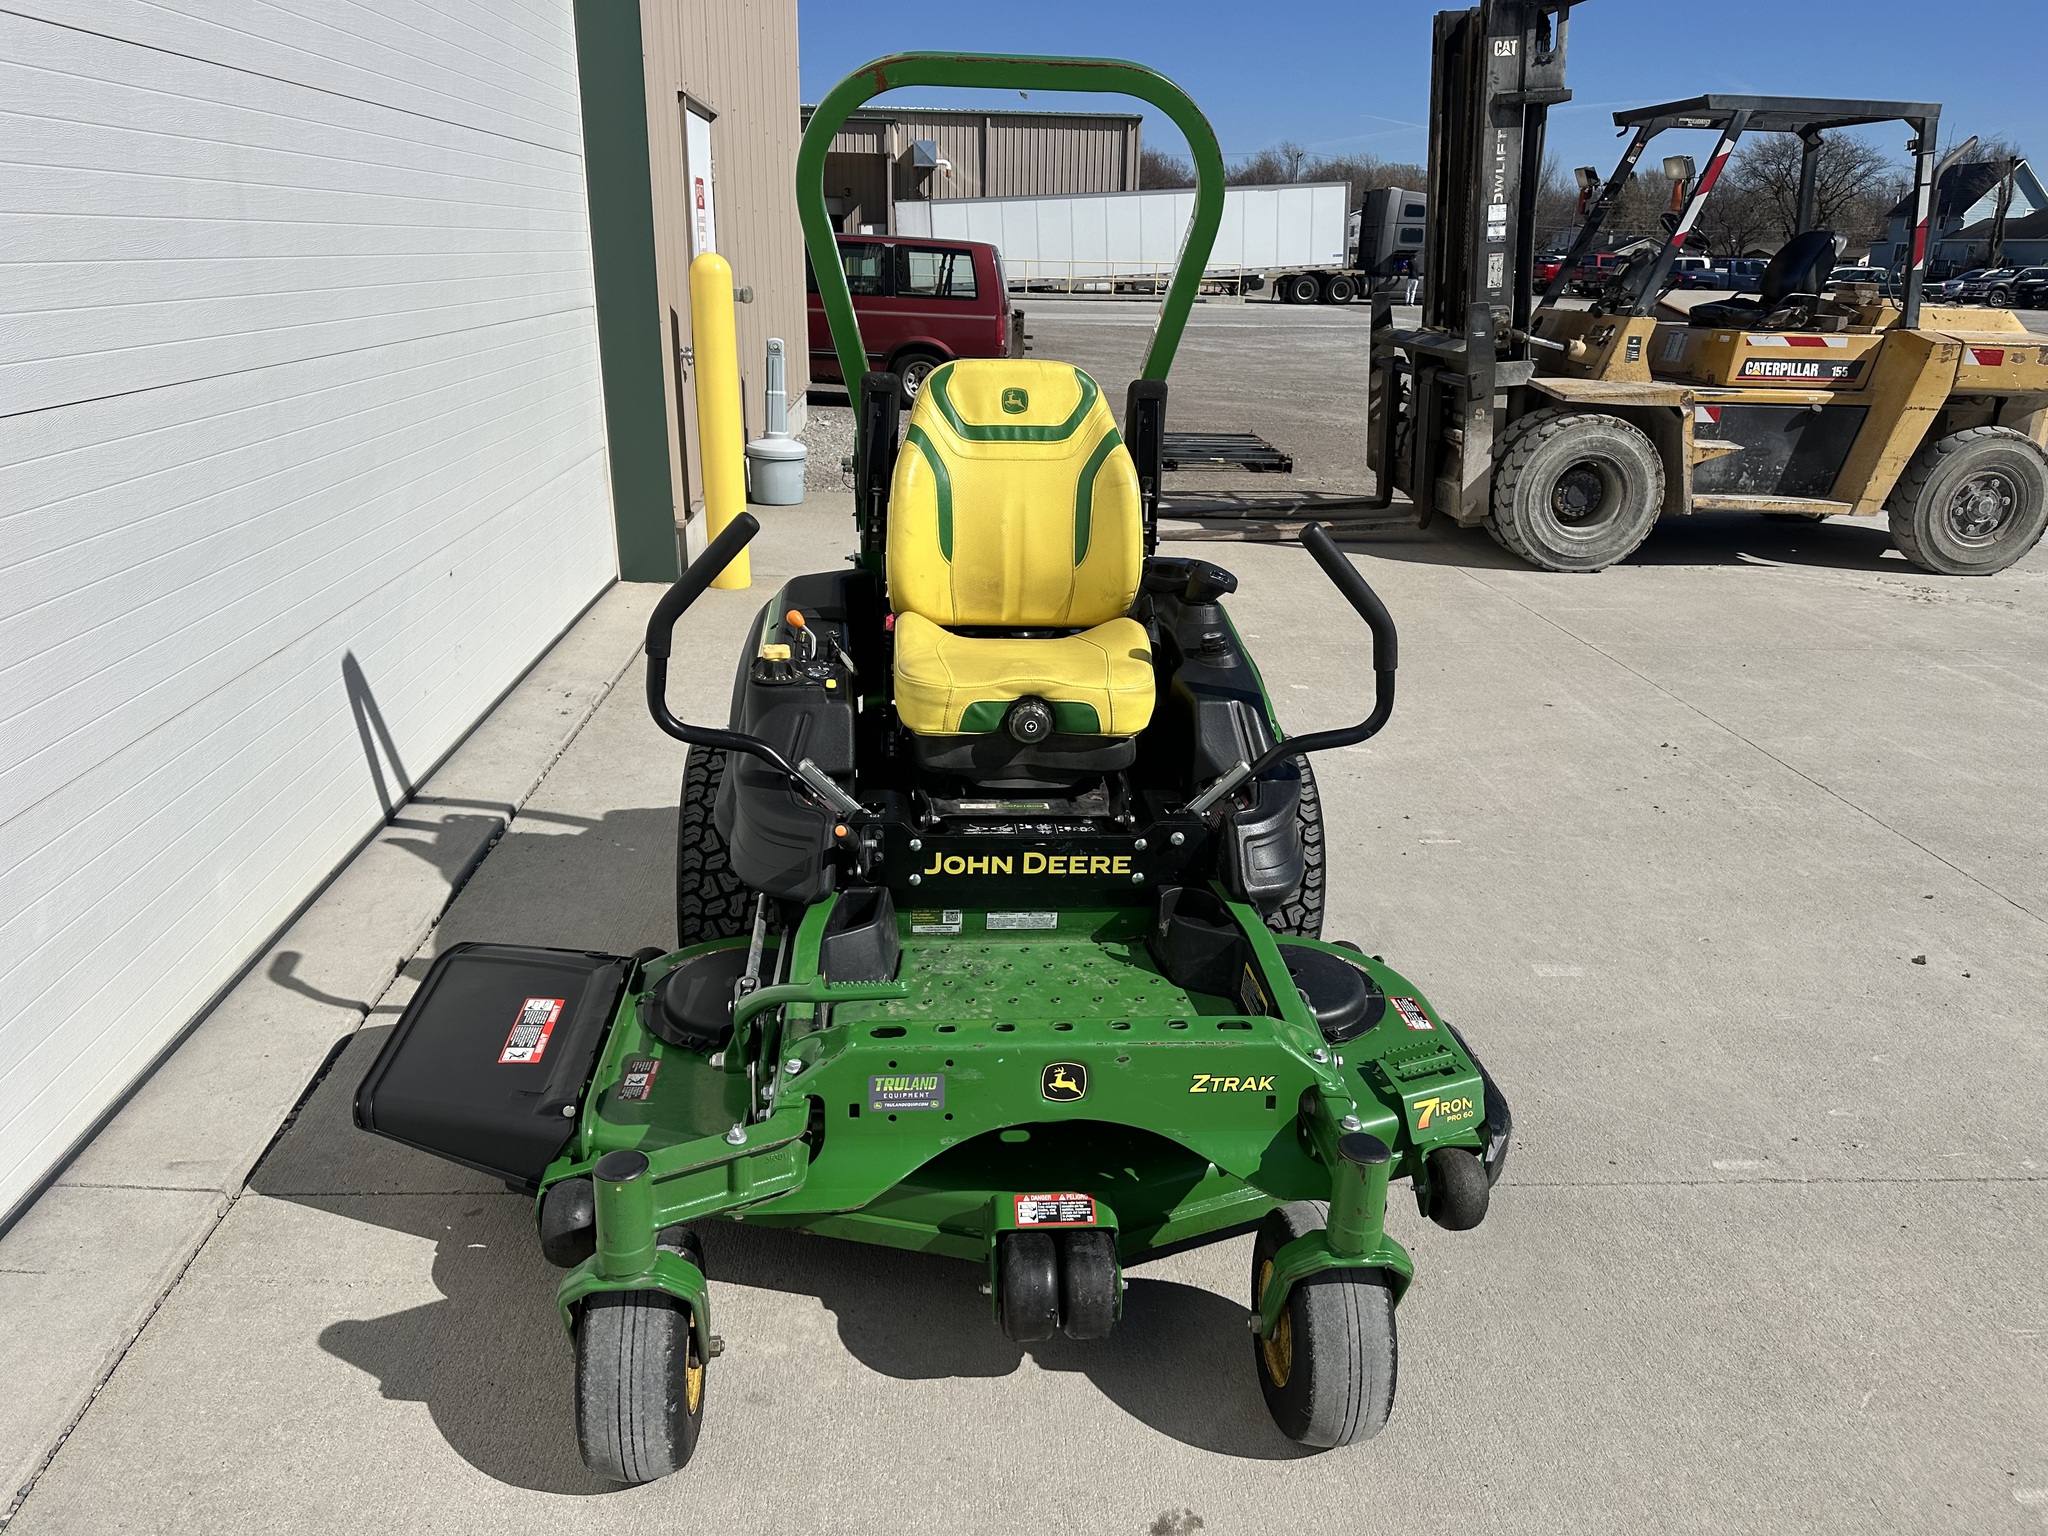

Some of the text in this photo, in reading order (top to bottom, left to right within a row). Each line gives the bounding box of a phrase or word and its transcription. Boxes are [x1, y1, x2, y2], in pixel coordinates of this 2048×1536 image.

[1494, 40, 1517, 57] CAT
[844, 187, 851, 197] 3
[1745, 361, 1848, 378] CATERPILLAR 155
[924, 852, 1132, 875] JOHN DEERE
[875, 1076, 938, 1092] TRULAND
[1189, 1074, 1277, 1093] ZTRAK
[1413, 1097, 1473, 1130] 7 IRON
[1446, 1110, 1474, 1123] PRO 60
